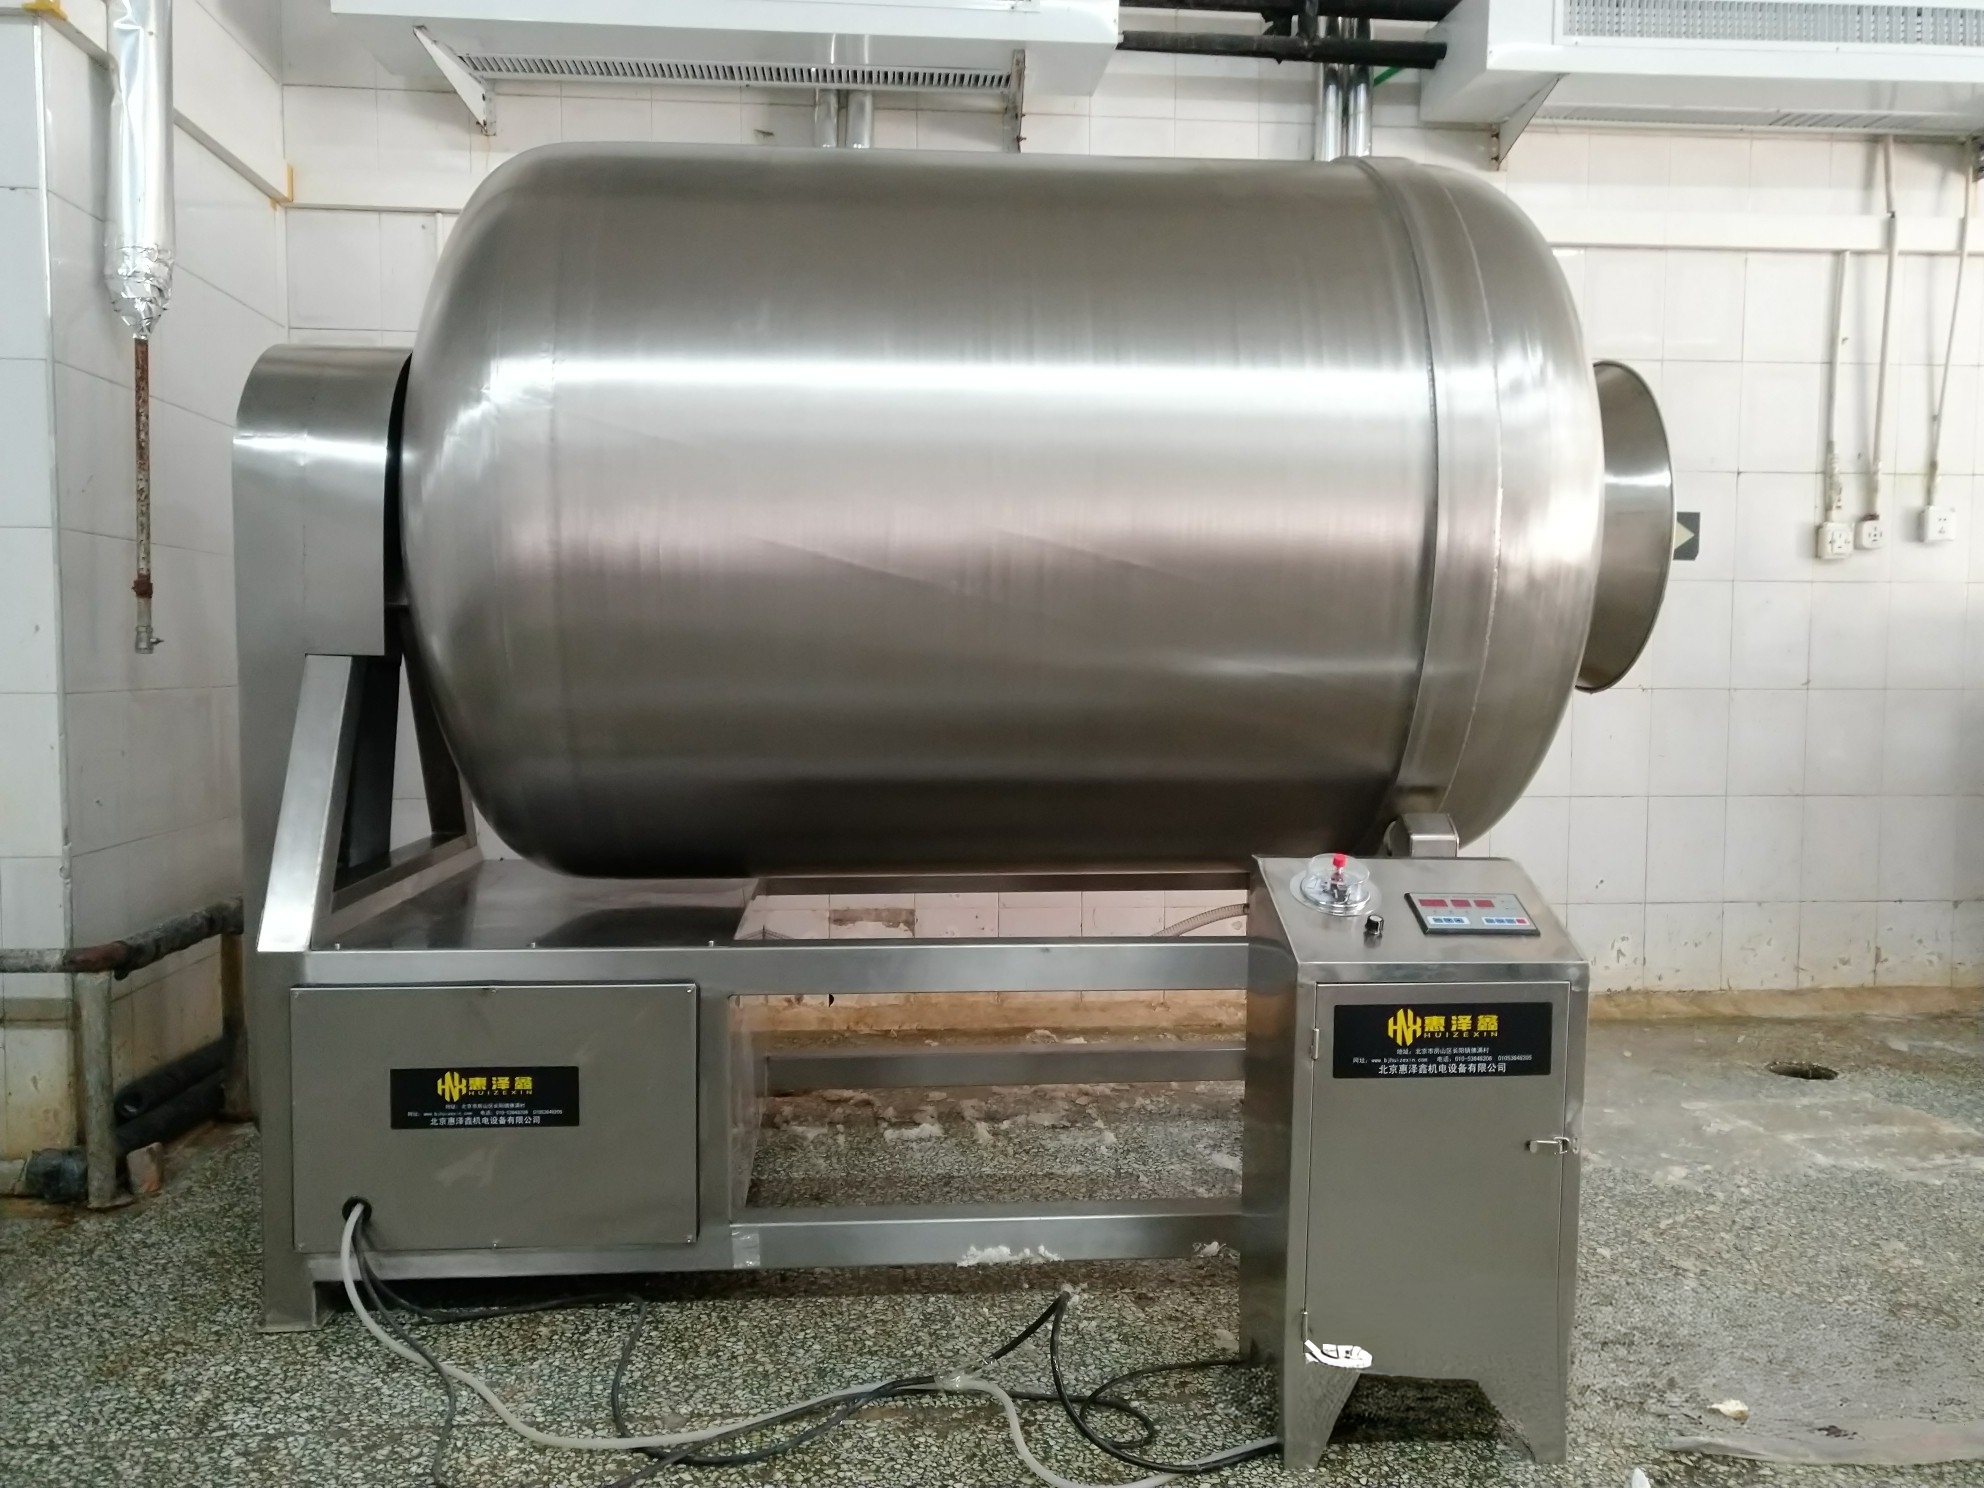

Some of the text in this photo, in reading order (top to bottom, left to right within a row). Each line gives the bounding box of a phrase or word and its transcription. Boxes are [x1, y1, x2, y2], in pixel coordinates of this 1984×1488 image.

[1424, 1014, 1499, 1032] 惠泽鑫
[1423, 1031, 1498, 1039] HUIZEXIN
[1378, 1062, 1507, 1075] 北京惠泽鑫机电设备有限公司
[468, 1076, 533, 1090] 惠泽鑫
[430, 1115, 541, 1126] 北京惠泽鑫机电设备有限公司
